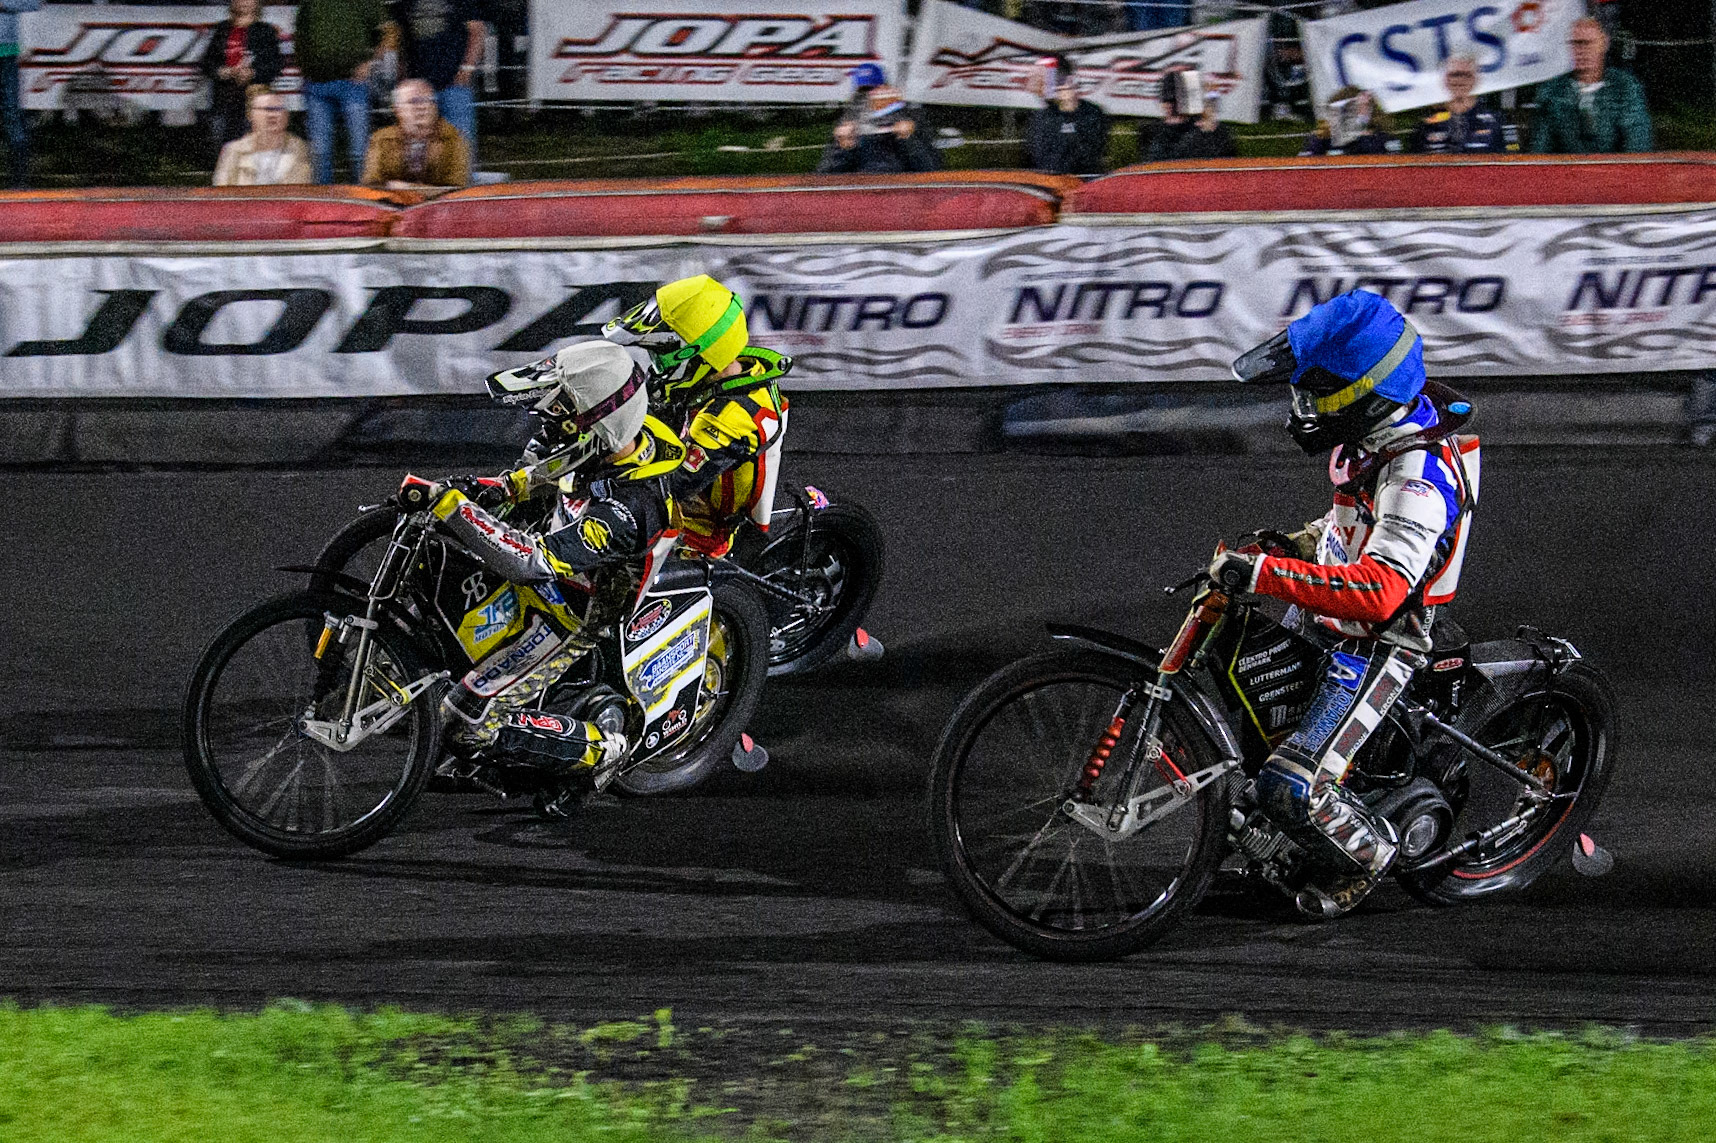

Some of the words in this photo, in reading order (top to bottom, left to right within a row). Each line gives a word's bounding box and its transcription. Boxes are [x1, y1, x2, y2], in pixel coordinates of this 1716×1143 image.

[552, 13, 878, 60] JOPA
[3, 281, 664, 357] JOPA
[744, 290, 951, 333] NITRO
[1010, 279, 1226, 324] NITRO
[473, 624, 553, 689] TORNADO
[1304, 688, 1355, 753] JOHANNES
